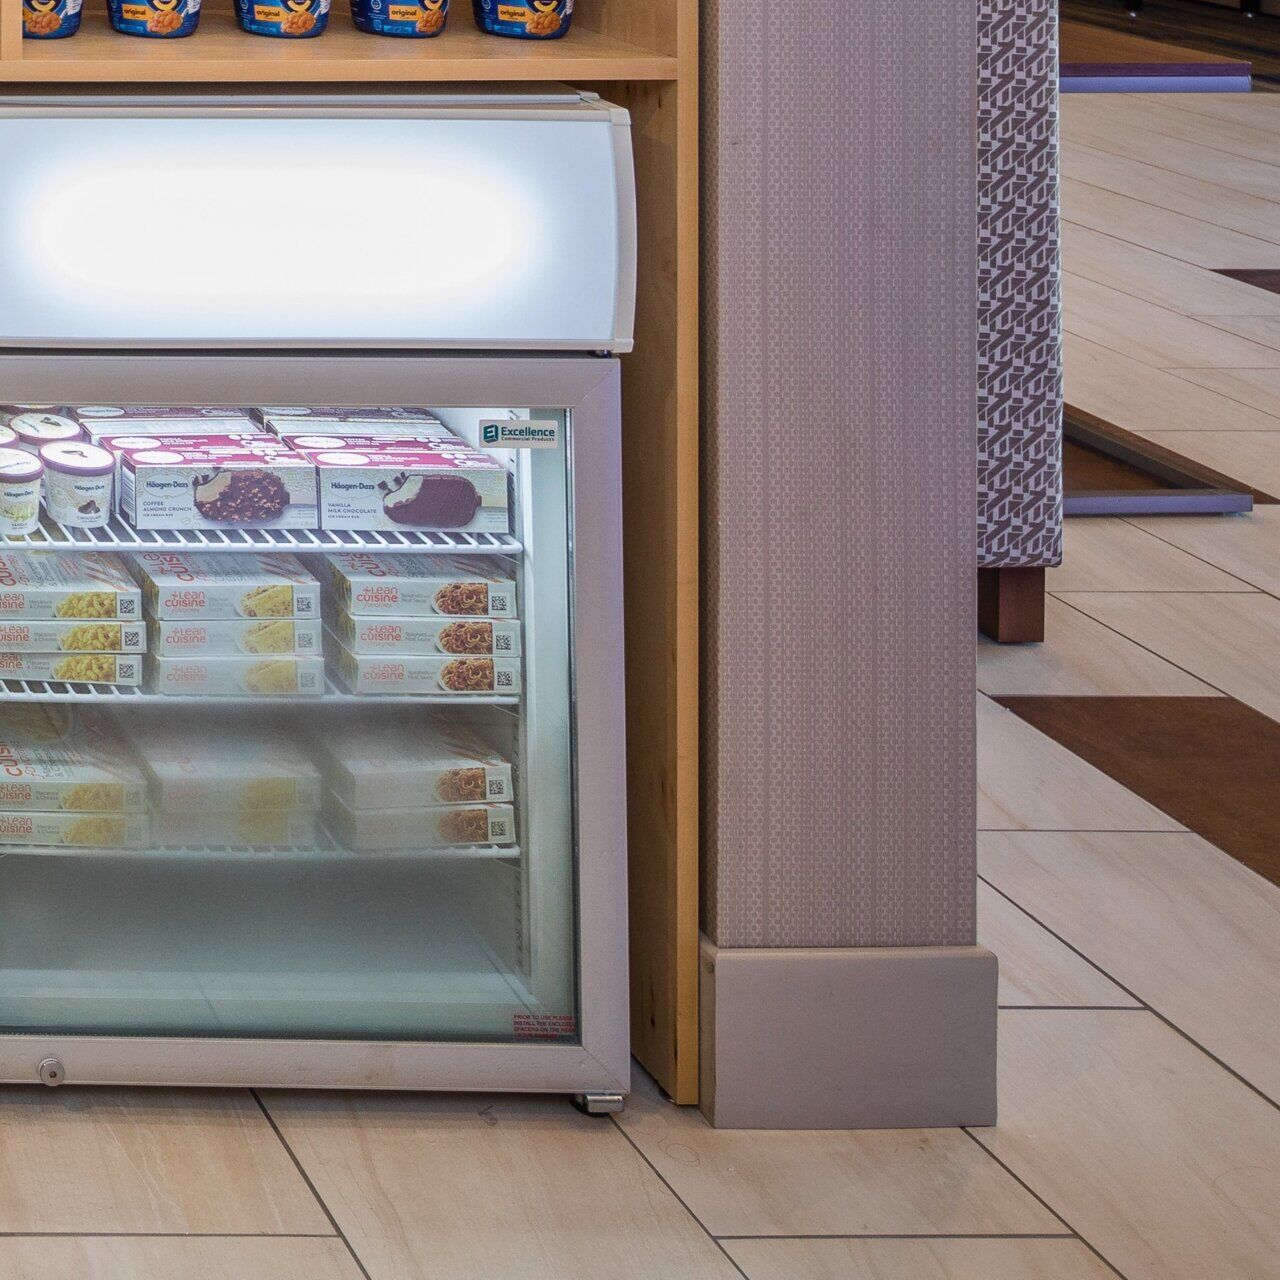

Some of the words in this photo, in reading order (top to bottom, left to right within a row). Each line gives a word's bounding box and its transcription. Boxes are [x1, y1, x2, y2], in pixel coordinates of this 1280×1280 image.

[256, 9, 281, 18] original
[392, 9, 417, 18] original
[500, 9, 526, 18] original
[501, 426, 555, 437] Excellence
[363, 671, 404, 680] cuisine
